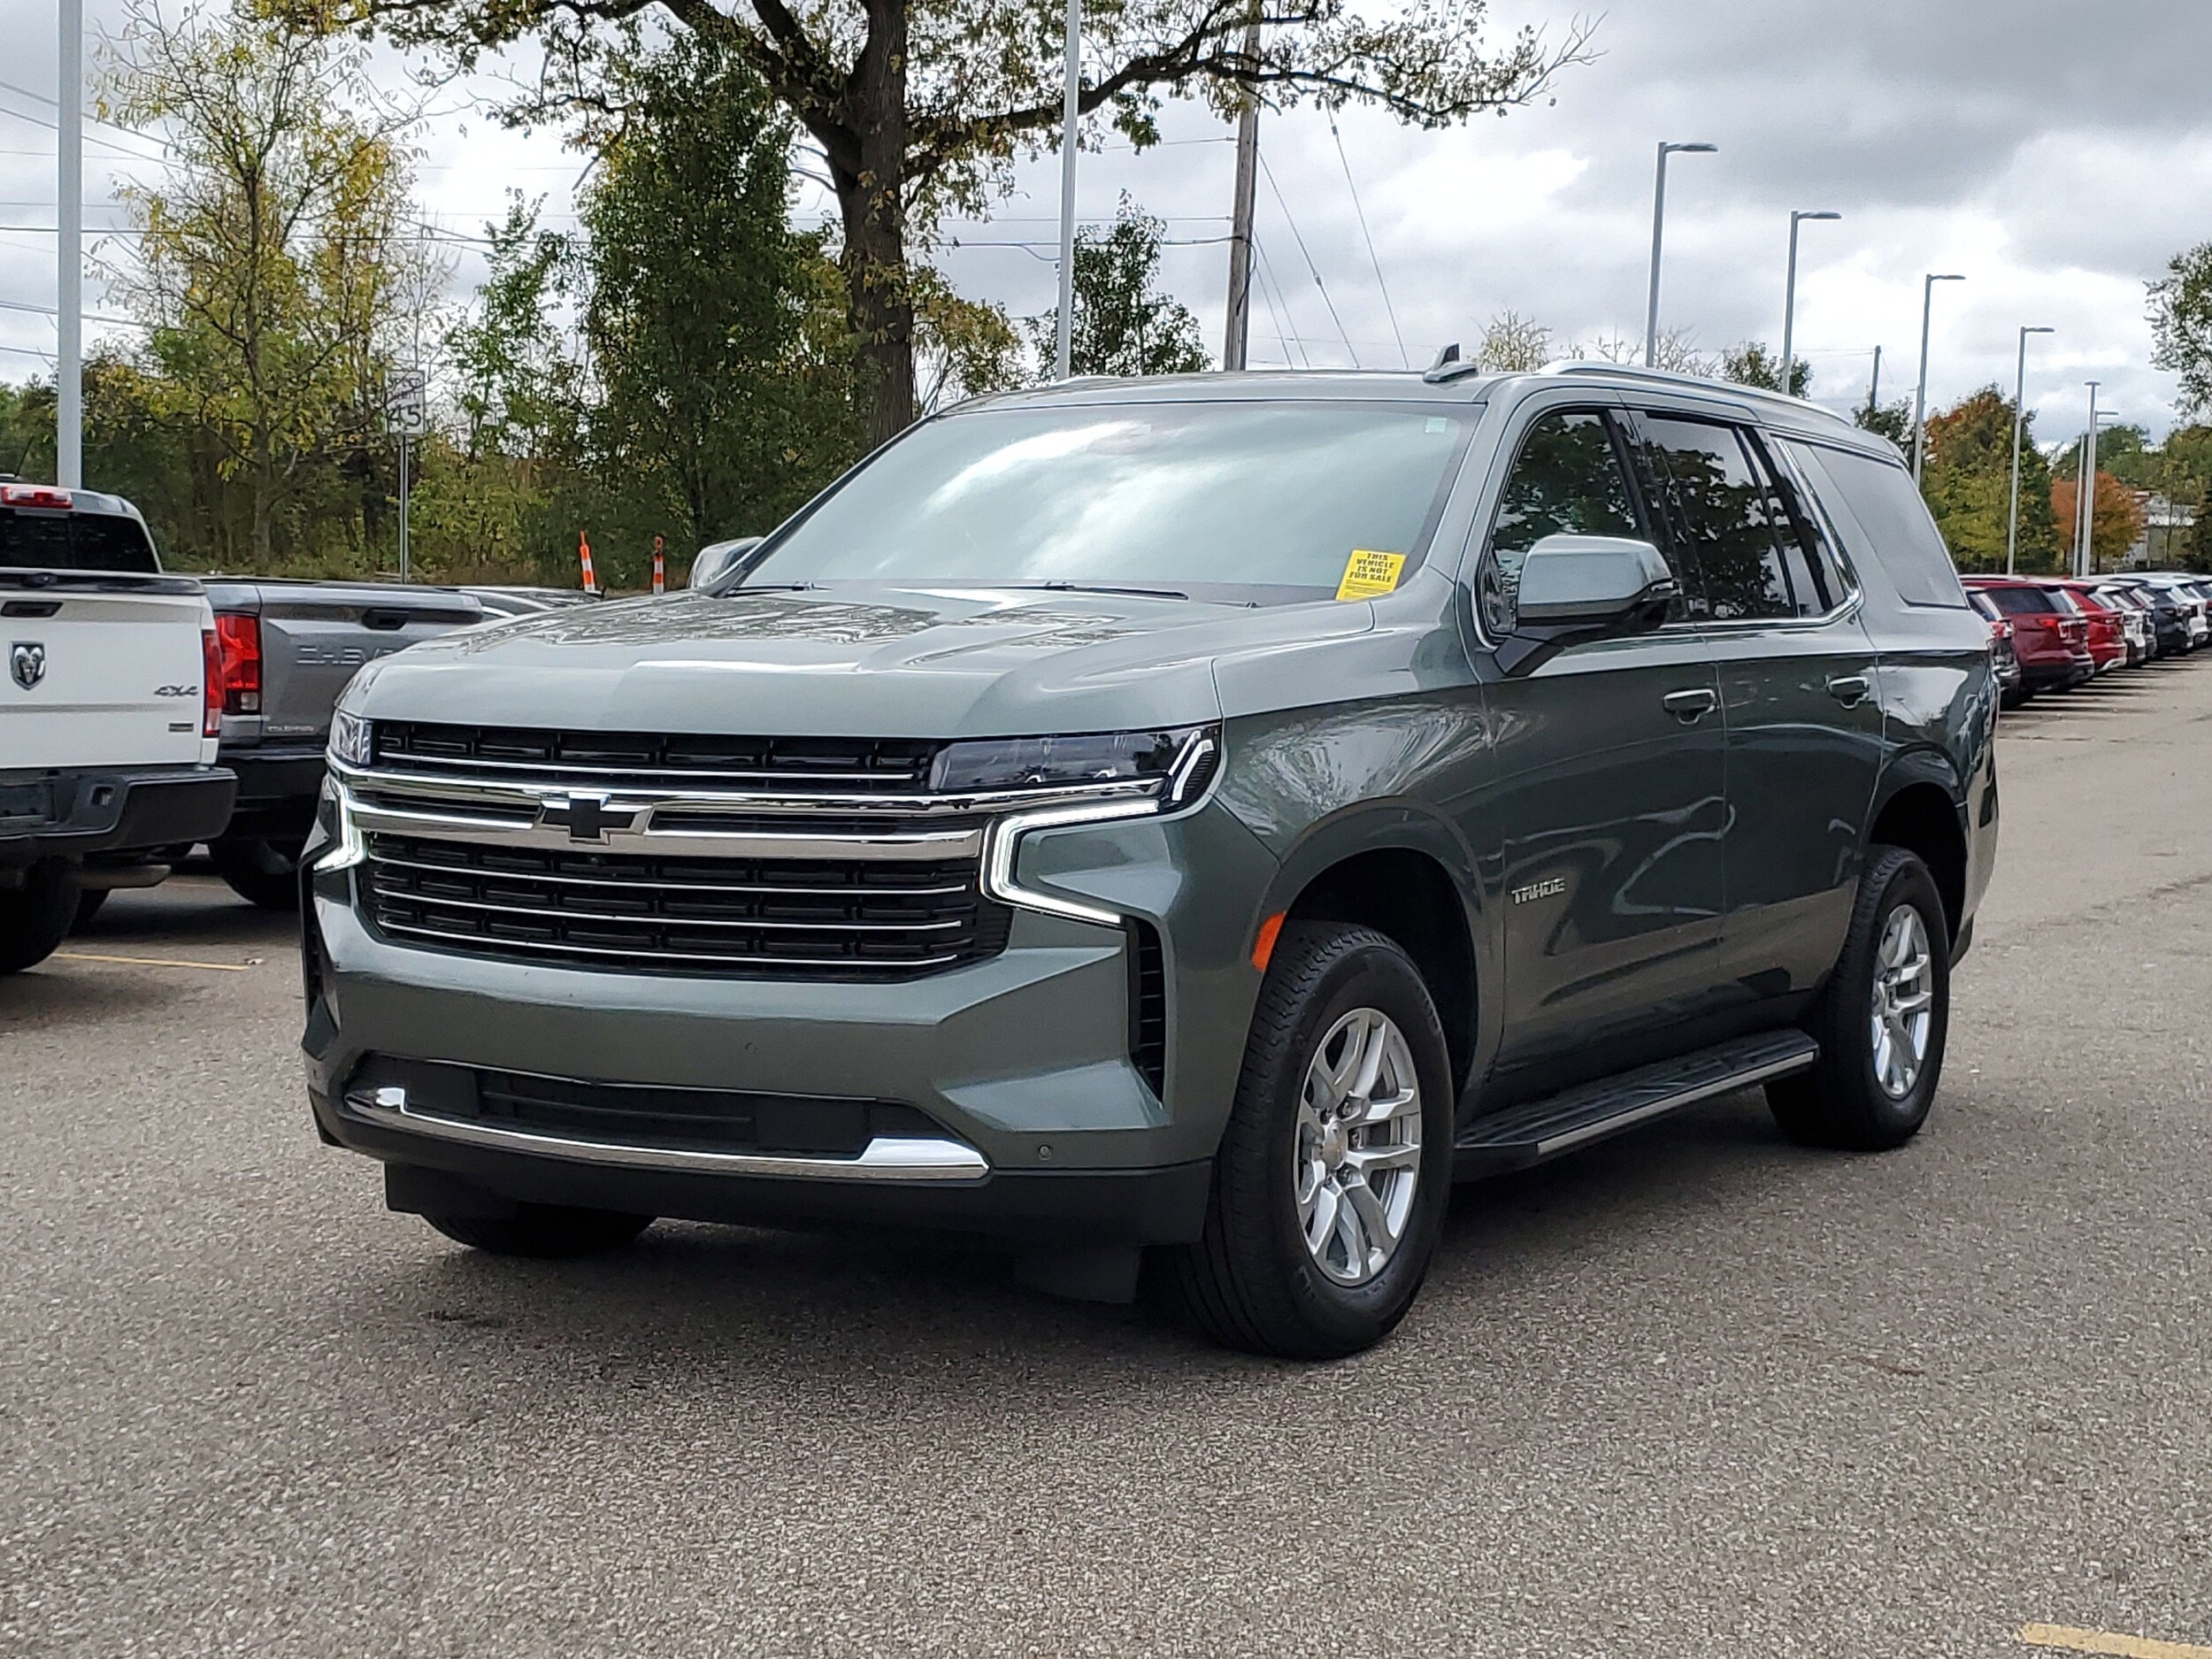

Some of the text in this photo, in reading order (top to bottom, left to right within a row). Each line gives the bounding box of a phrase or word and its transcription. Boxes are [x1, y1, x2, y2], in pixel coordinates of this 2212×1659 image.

[388, 403, 422, 427] 45
[1356, 558, 1395, 568] VEHICLE
[1369, 574, 1392, 583] SALE
[1511, 877, 1565, 904] TAHOE
